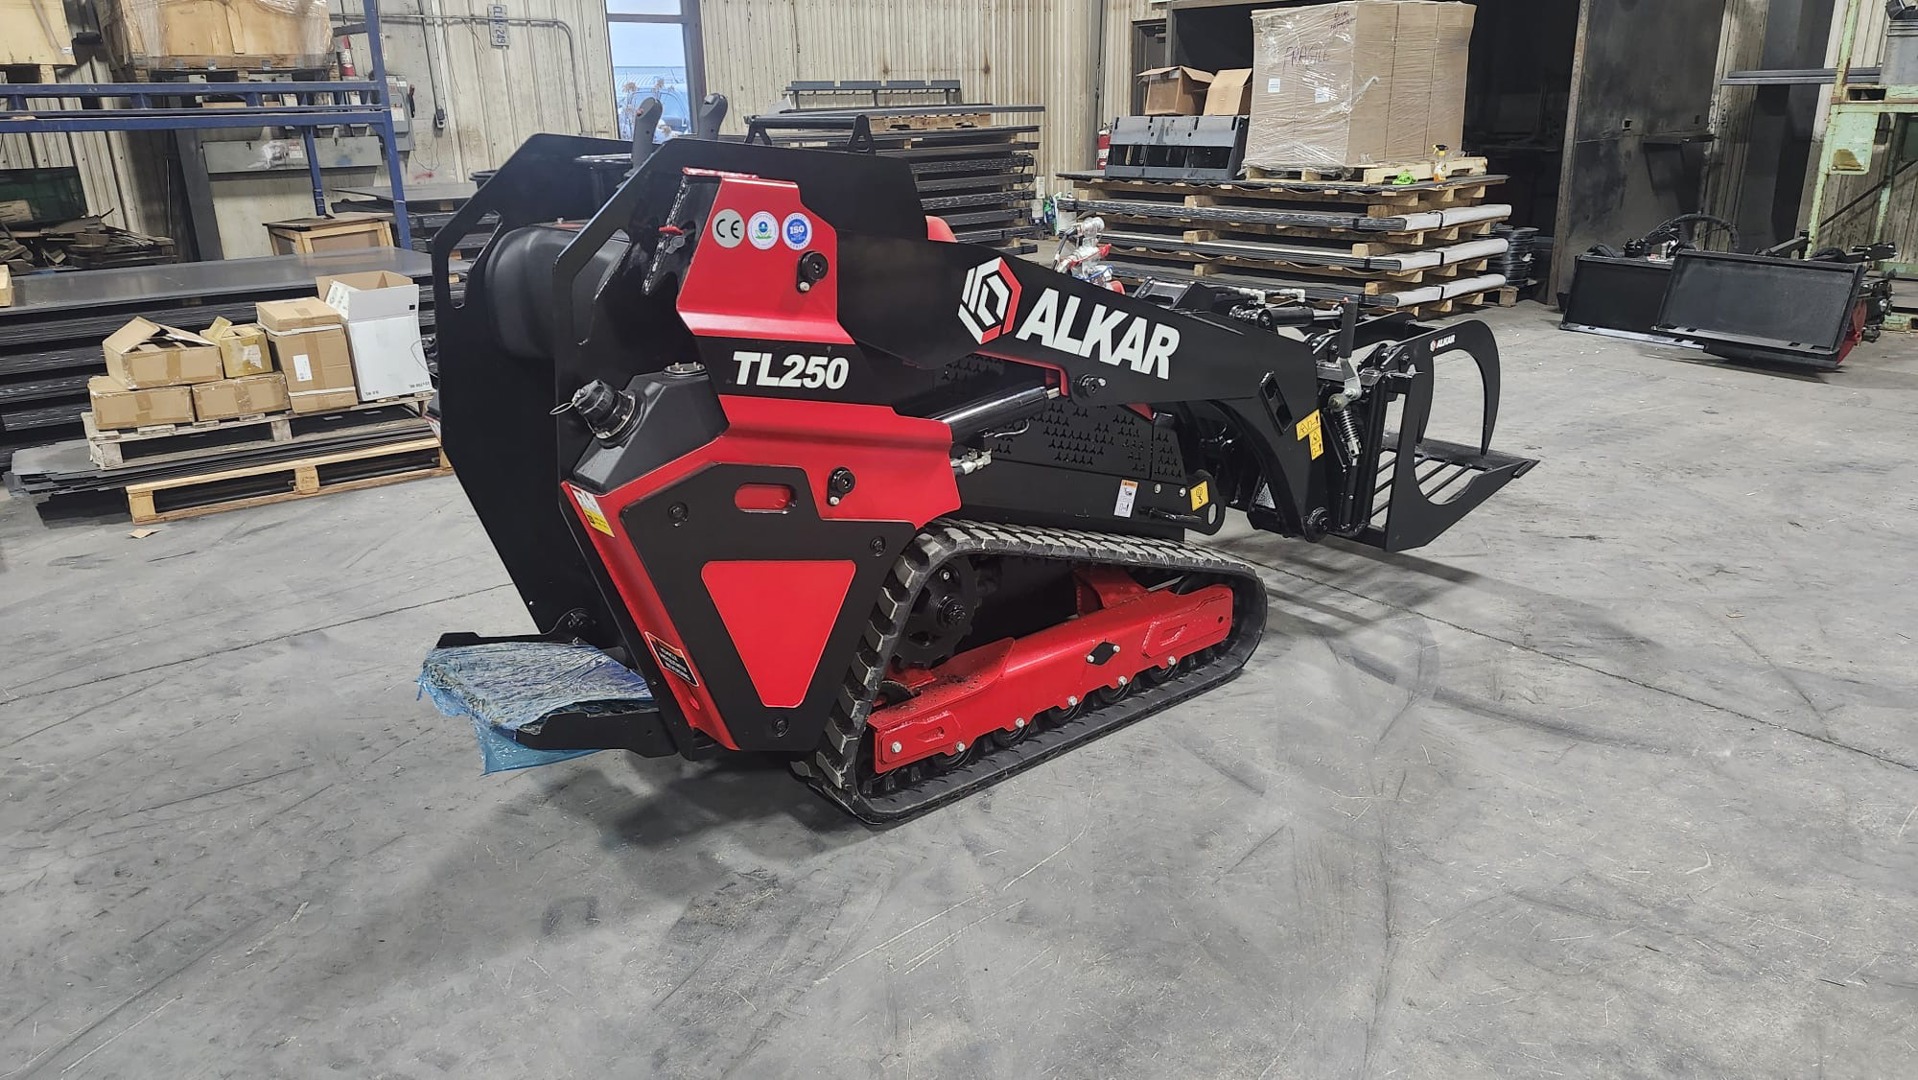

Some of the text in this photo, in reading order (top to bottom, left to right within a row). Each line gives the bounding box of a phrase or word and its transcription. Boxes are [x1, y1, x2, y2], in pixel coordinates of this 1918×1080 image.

[1283, 45, 1329, 70] FRAGILE
[716, 218, 740, 240] CE
[789, 225, 805, 235] ISO
[1015, 287, 1181, 380] ALKAR
[733, 351, 850, 390] TL250
